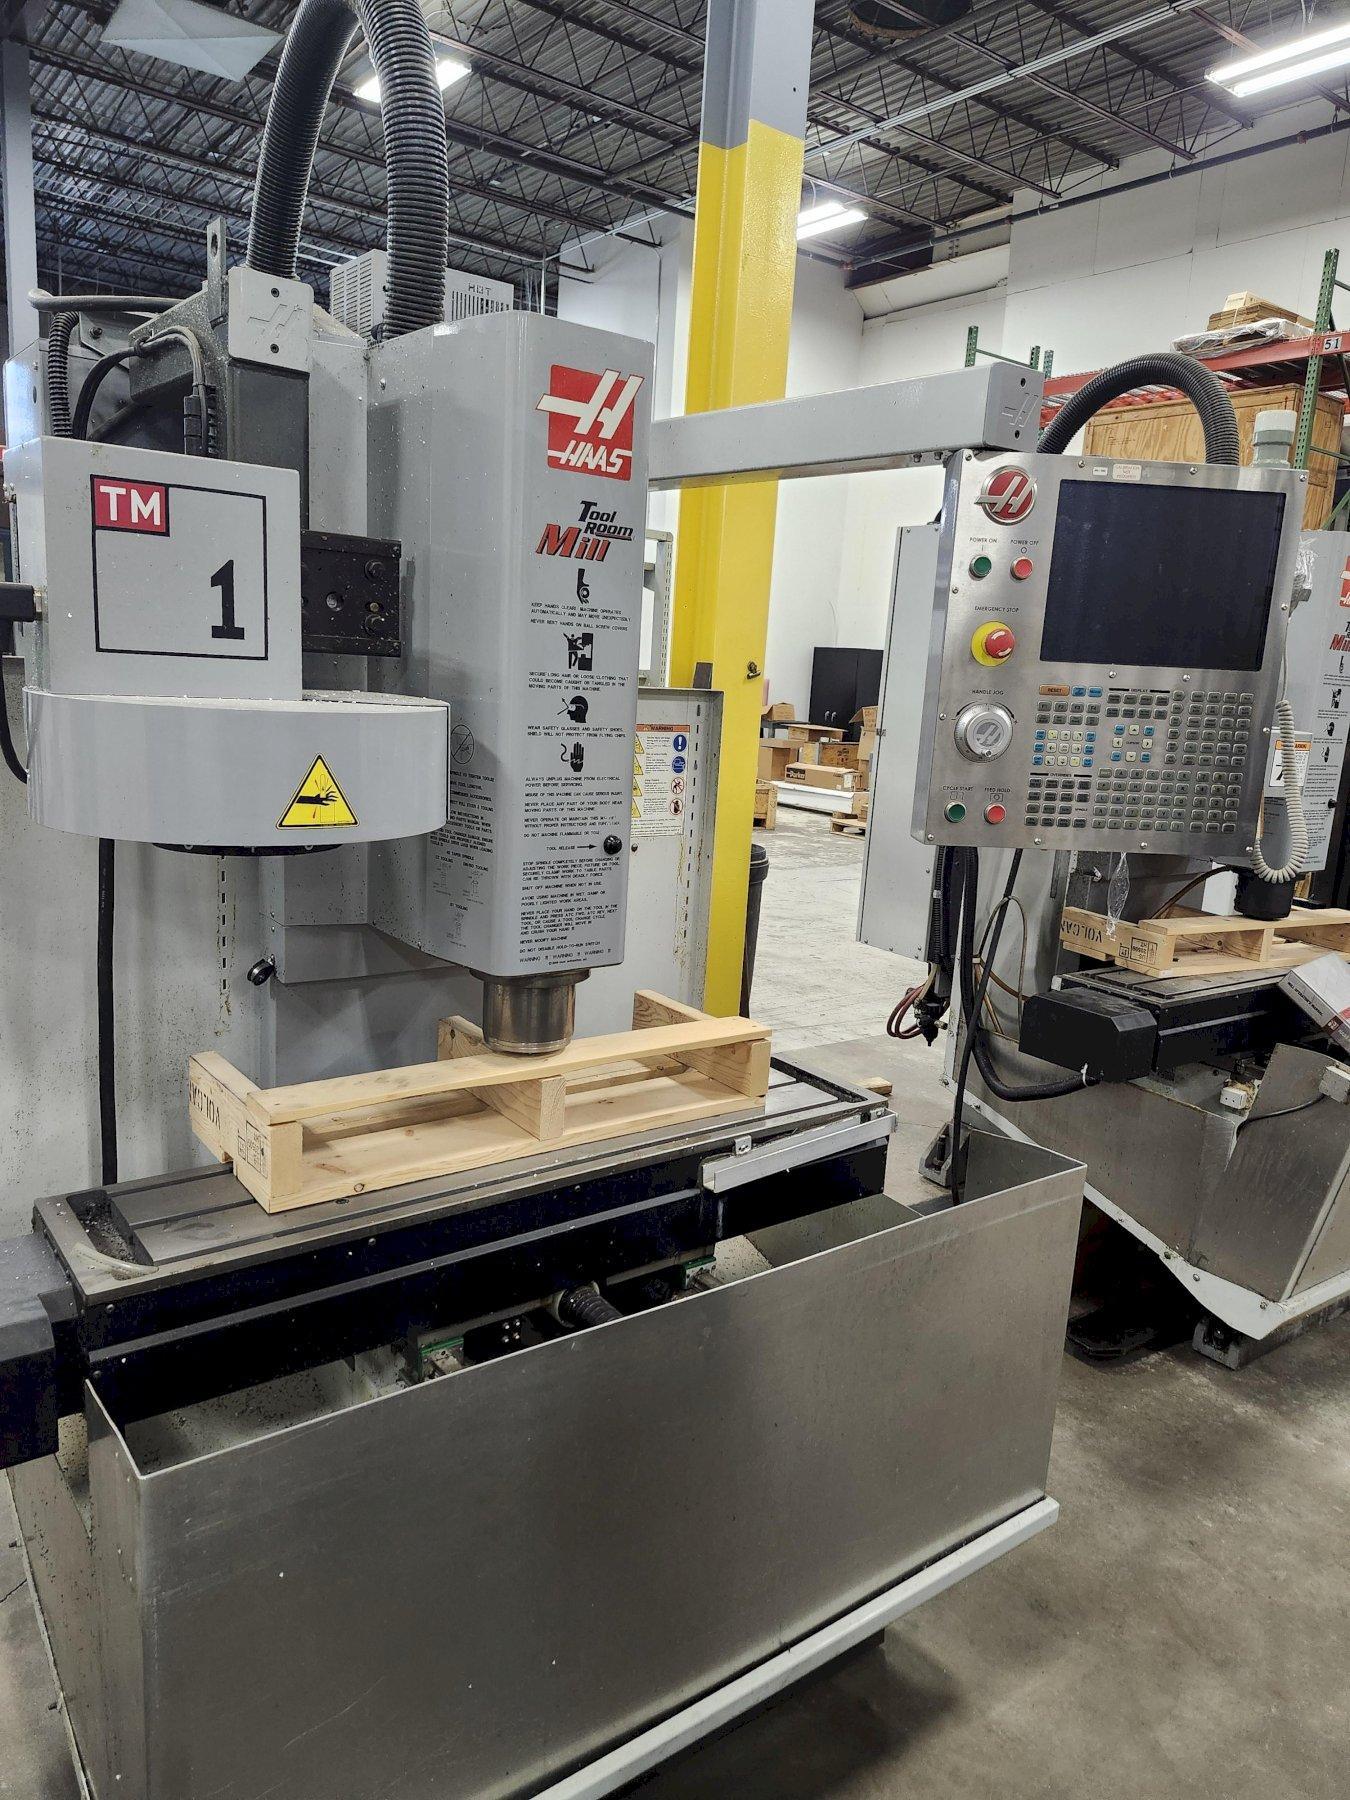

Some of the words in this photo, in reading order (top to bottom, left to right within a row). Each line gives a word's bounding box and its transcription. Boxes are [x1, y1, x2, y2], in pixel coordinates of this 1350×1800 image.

[1324, 337, 1341, 350] 51
[548, 439, 633, 474] HAAS
[100, 485, 161, 526] TM
[578, 500, 617, 523] Tool
[536, 523, 611, 562] Mill
[211, 559, 245, 640] 1
